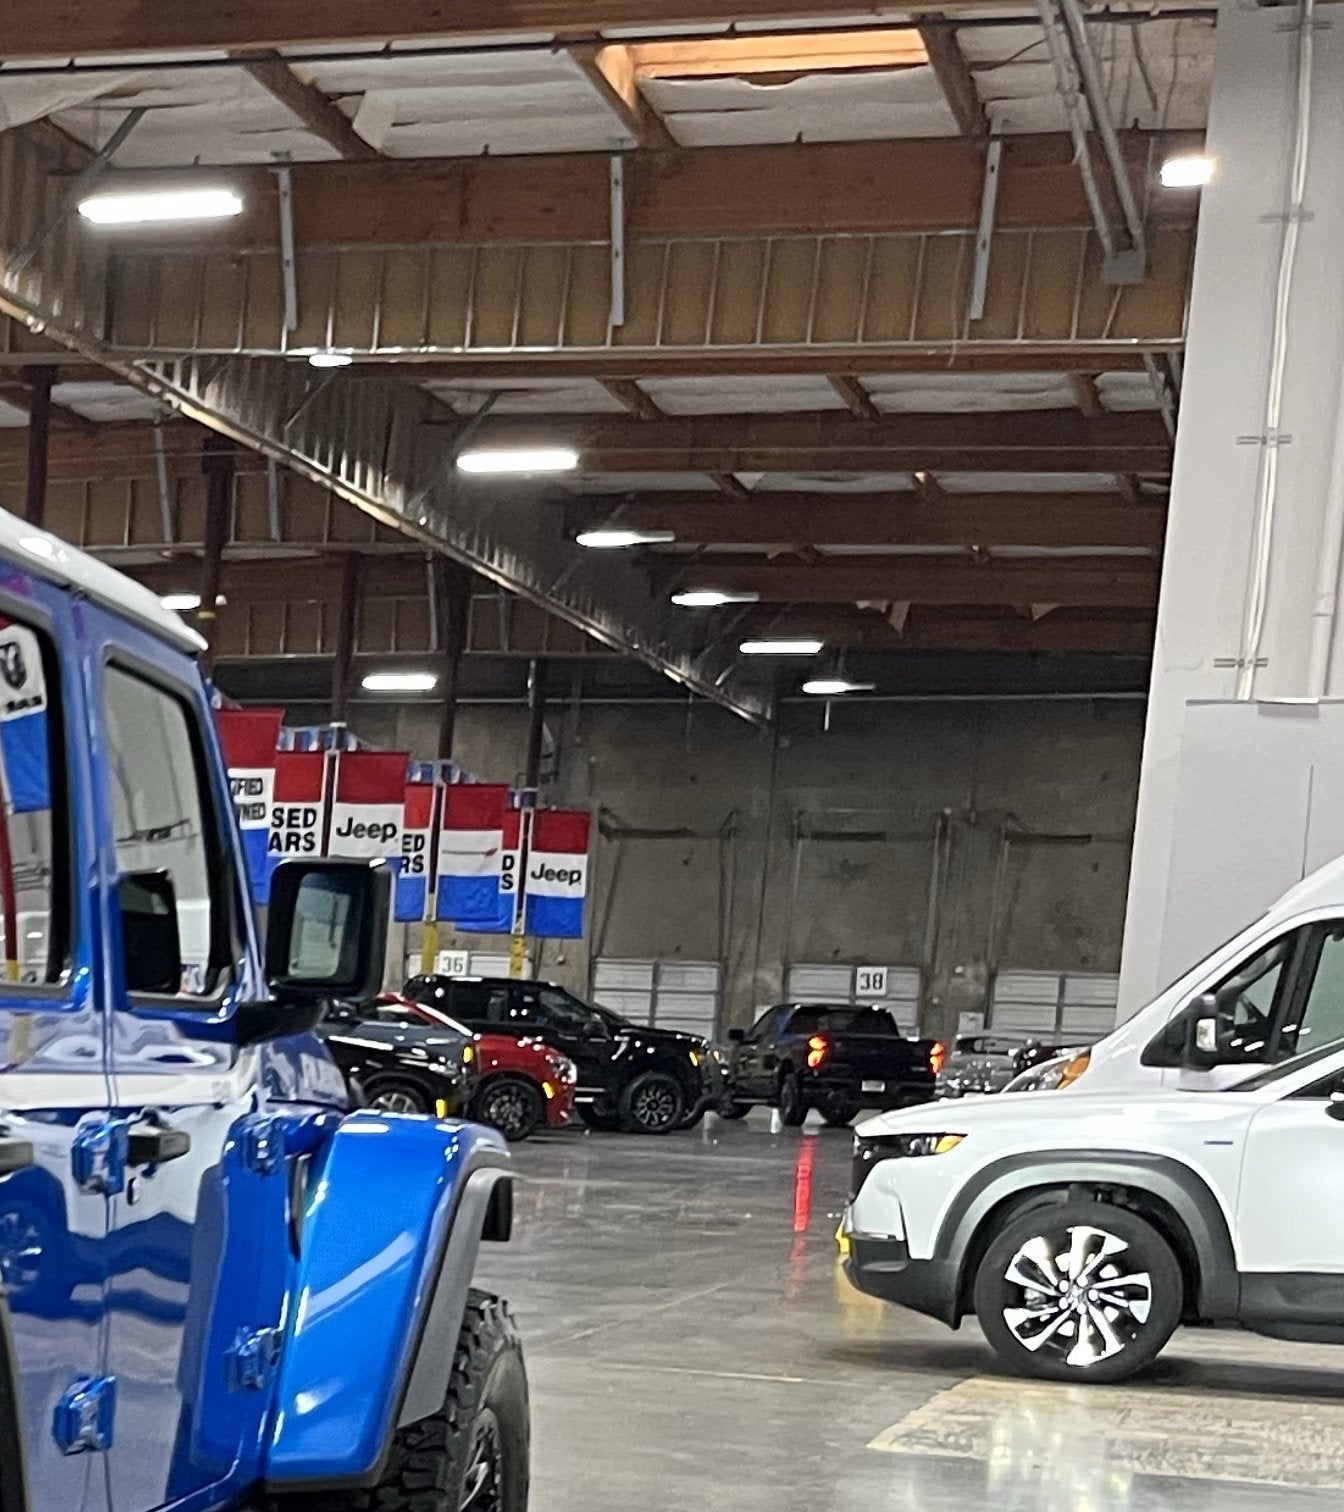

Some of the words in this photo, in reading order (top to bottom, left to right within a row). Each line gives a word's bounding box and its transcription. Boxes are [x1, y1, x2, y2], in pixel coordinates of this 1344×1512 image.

[271, 807, 317, 829] SED
[336, 816, 398, 843] Jeep
[268, 832, 316, 853] ARS
[401, 833, 426, 853] ED
[400, 855, 425, 874] RS
[530, 863, 582, 886] Jeep
[859, 973, 884, 991] 38
